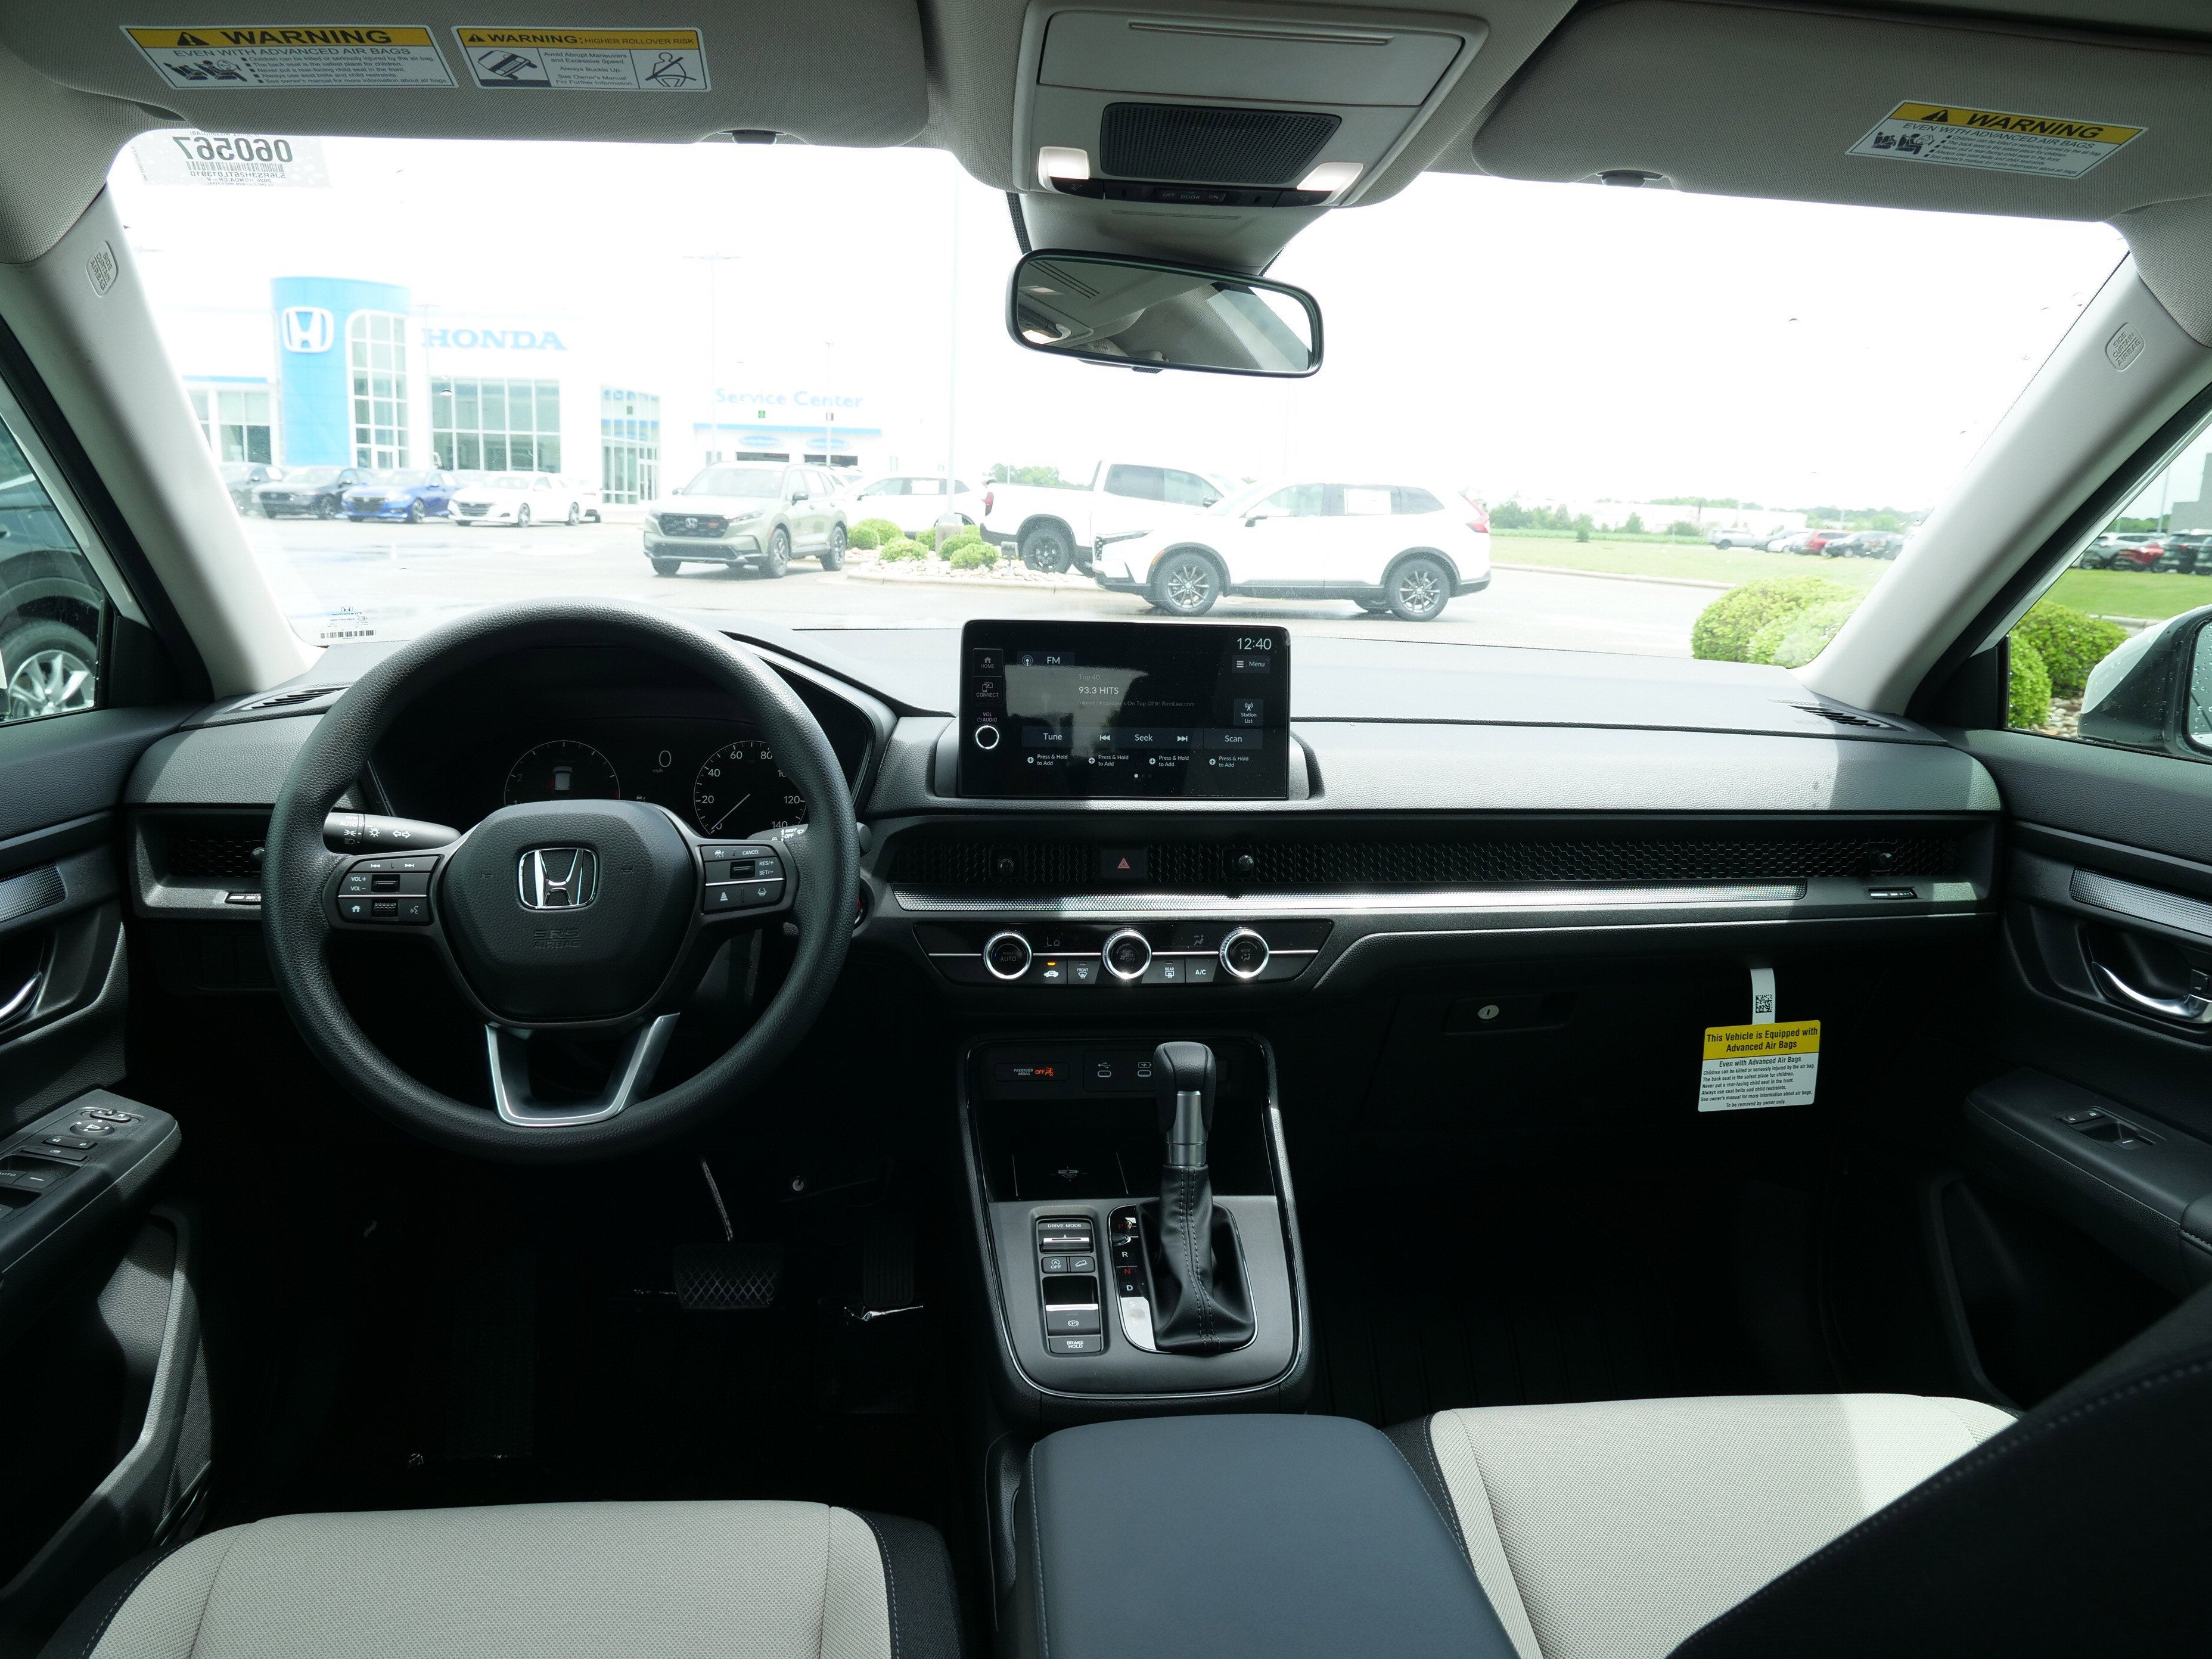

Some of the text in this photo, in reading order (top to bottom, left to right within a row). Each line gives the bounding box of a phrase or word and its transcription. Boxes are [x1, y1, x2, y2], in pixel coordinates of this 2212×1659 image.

[220, 31, 392, 44] WARNING
[487, 34, 583, 44] WARNING:
[1966, 113, 2104, 138] WARNING
[1940, 126, 1970, 135] WITH
[1970, 131, 2037, 142] ADVANCED
[2060, 140, 2095, 149] BAGS
[421, 328, 568, 351] HONDA
[715, 388, 863, 408] Service Center
[1237, 638, 1271, 650] 12:40
[658, 750, 672, 767] 0
[730, 751, 742, 759] 60
[760, 751, 773, 759] 80
[708, 769, 720, 777] 40
[702, 796, 714, 804] 20
[784, 796, 800, 804] 120
[533, 928, 579, 940] SRS
[533, 940, 581, 949] AIRBAG
[1047, 936, 1060, 946] Lo
[1725, 1032, 1753, 1041] Vehicle
[1765, 1029, 1800, 1039] Equipped
[1802, 1027, 1818, 1036] with
[1726, 1042, 1763, 1052] Advanced
[1779, 1040, 1797, 1049] Bags
